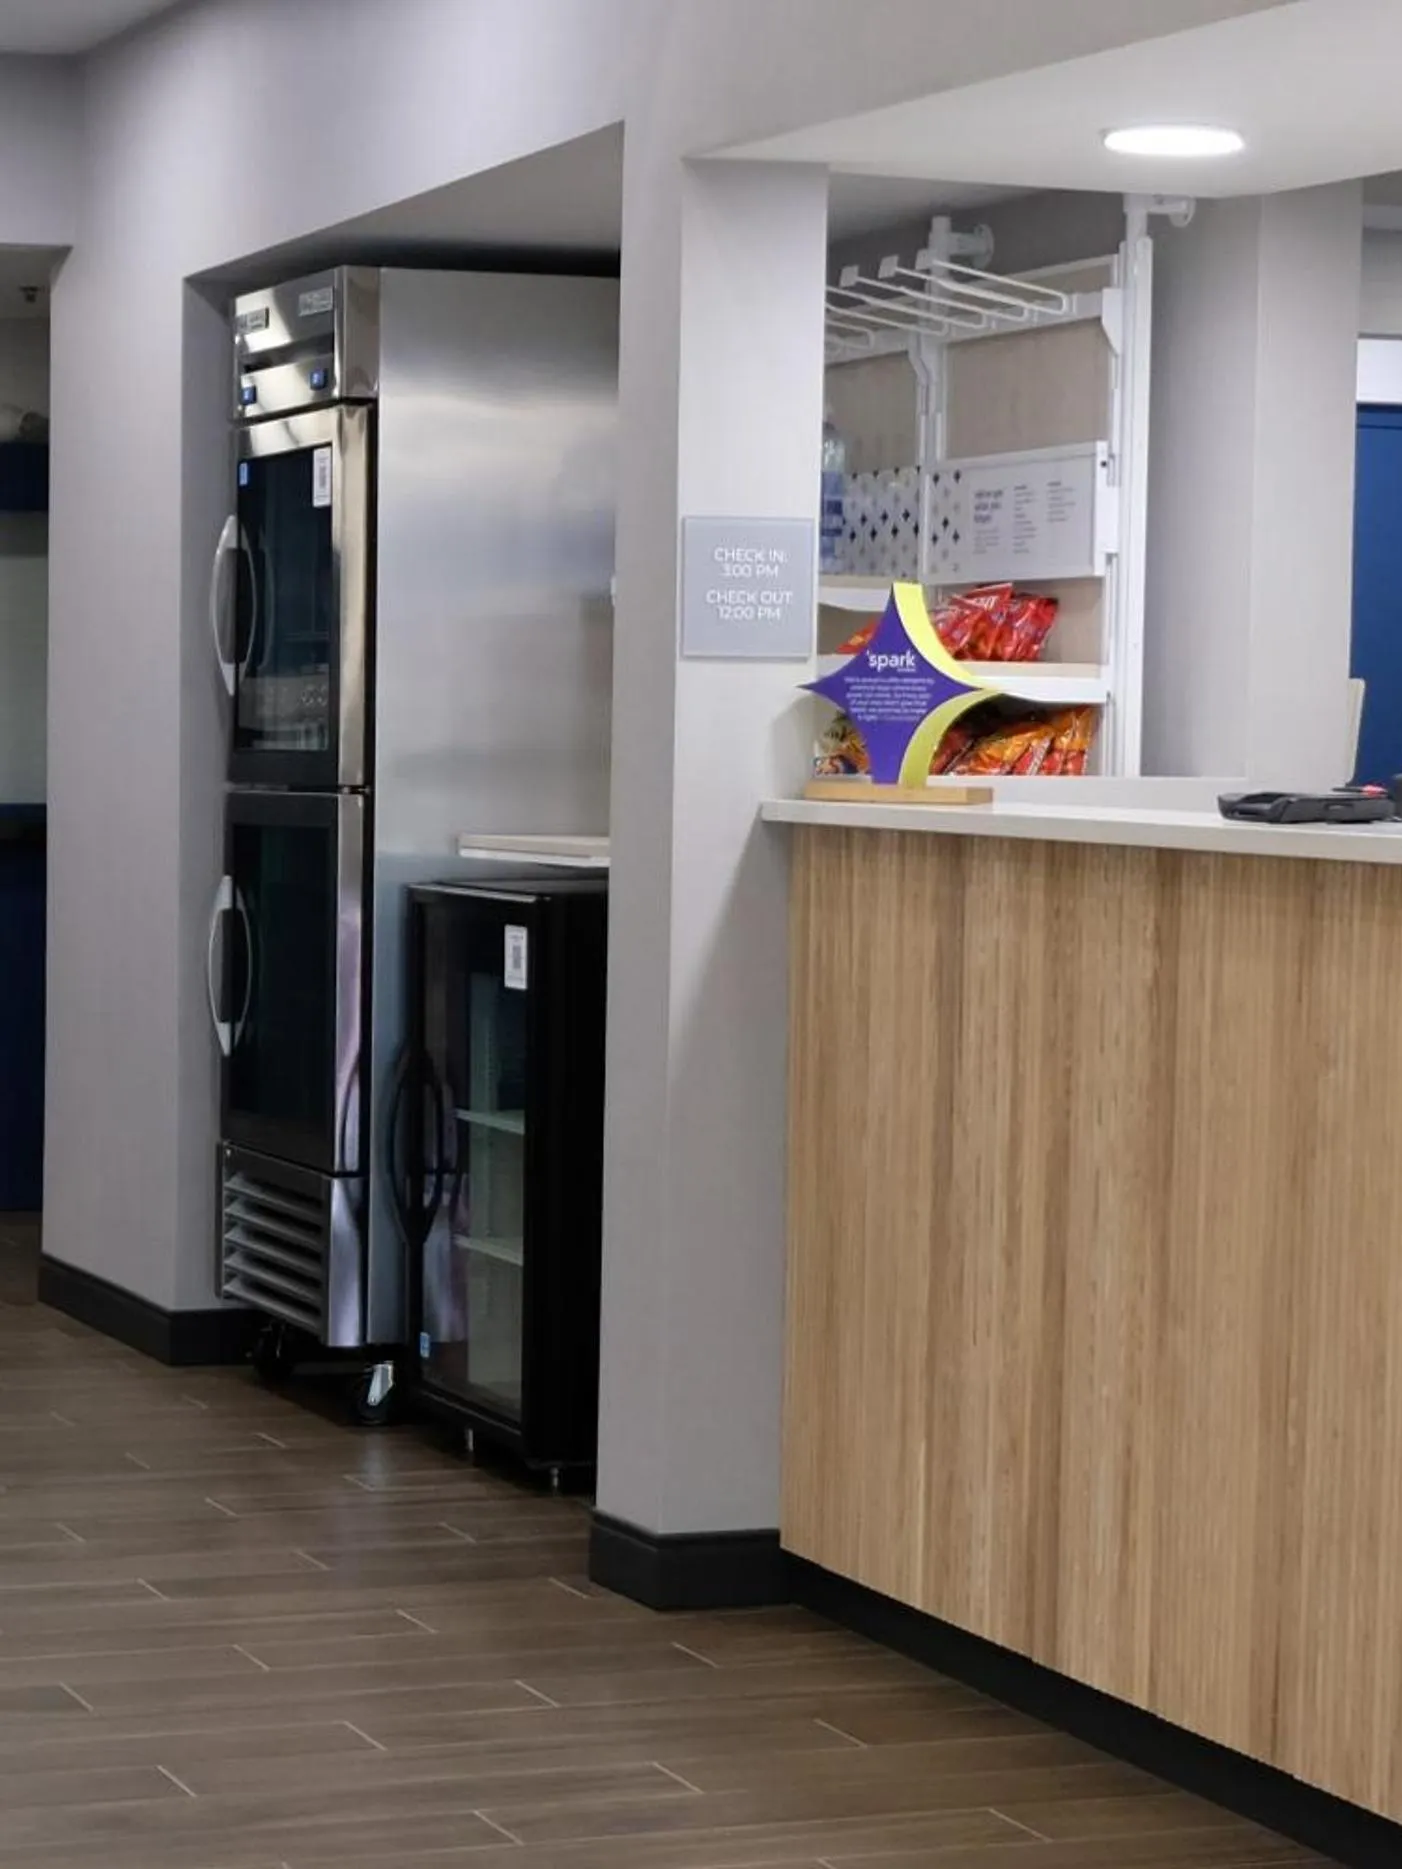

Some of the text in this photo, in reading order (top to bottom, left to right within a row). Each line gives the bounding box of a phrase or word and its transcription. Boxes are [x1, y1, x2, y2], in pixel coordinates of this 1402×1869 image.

[714, 547, 765, 562] CHECK
[756, 564, 778, 577] PM
[706, 590, 757, 604] CHECK
[758, 606, 780, 620] PM
